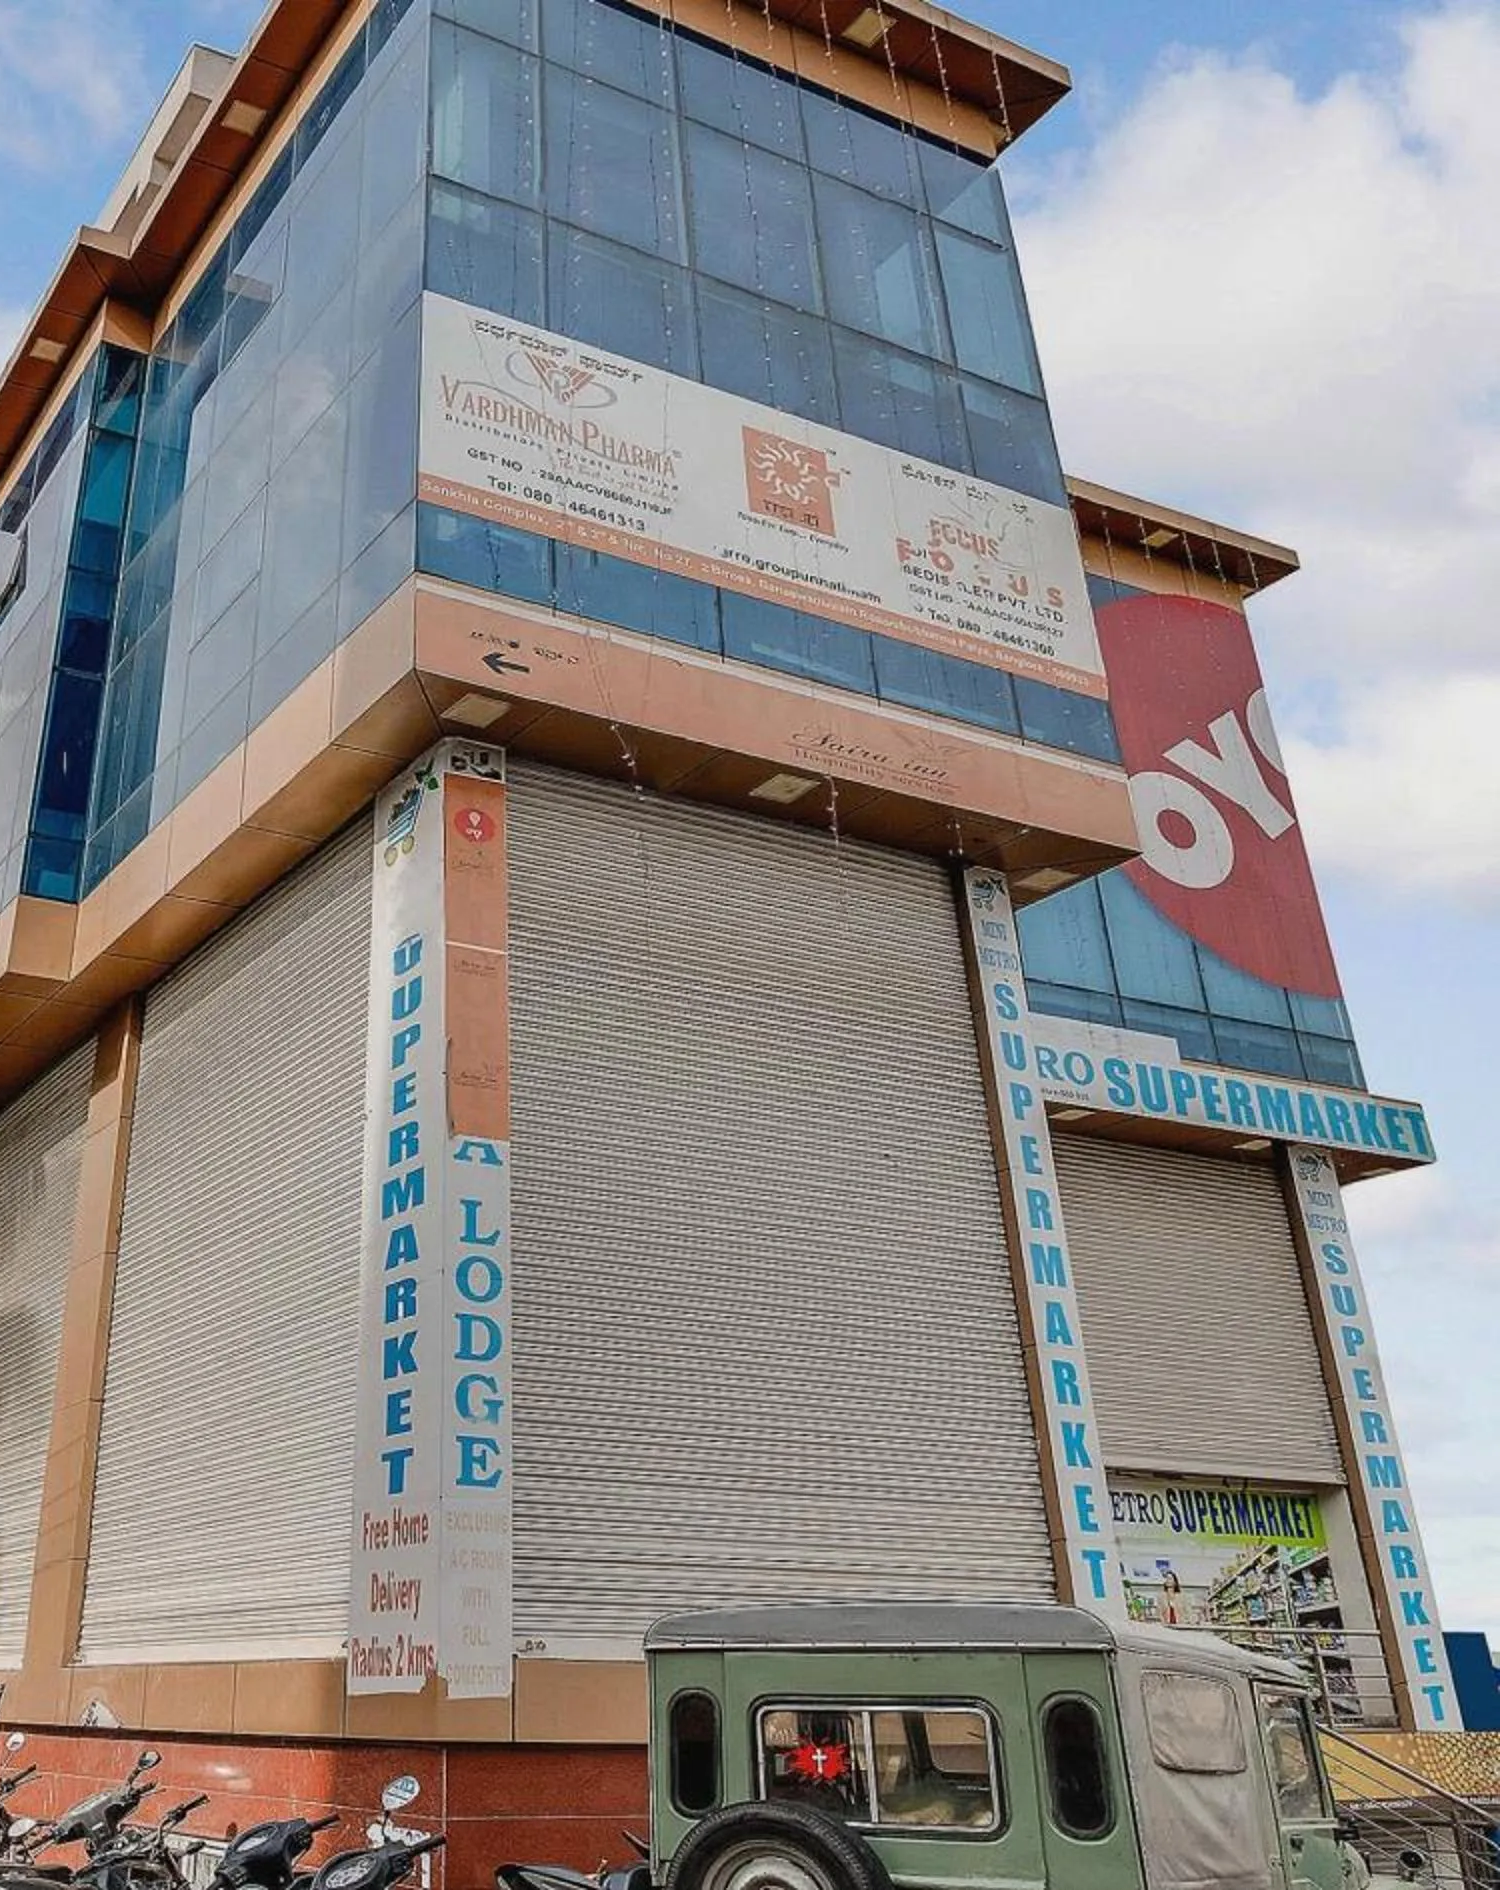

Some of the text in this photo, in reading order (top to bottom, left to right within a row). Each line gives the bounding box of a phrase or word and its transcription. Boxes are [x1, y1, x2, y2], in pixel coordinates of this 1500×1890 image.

[441, 375, 675, 477] VARDHMAN PHARMA
[467, 447, 499, 466] GST
[501, 458, 523, 473] NO
[523, 486, 553, 505] 080
[1102, 1056, 1430, 1156] SUPERMARKET
[994, 982, 1107, 1599] SUPERMARKET
[453, 1199, 505, 1489] LODGE
[1321, 1242, 1445, 1723] SUPERMARKET
[363, 1506, 430, 1551] Free Home
[1109, 1487, 1315, 1539] ETRO SUPERMARKET
[370, 1570, 422, 1621] Delivery
[351, 1636, 393, 1679] Radius
[395, 1634, 405, 1677] 2
